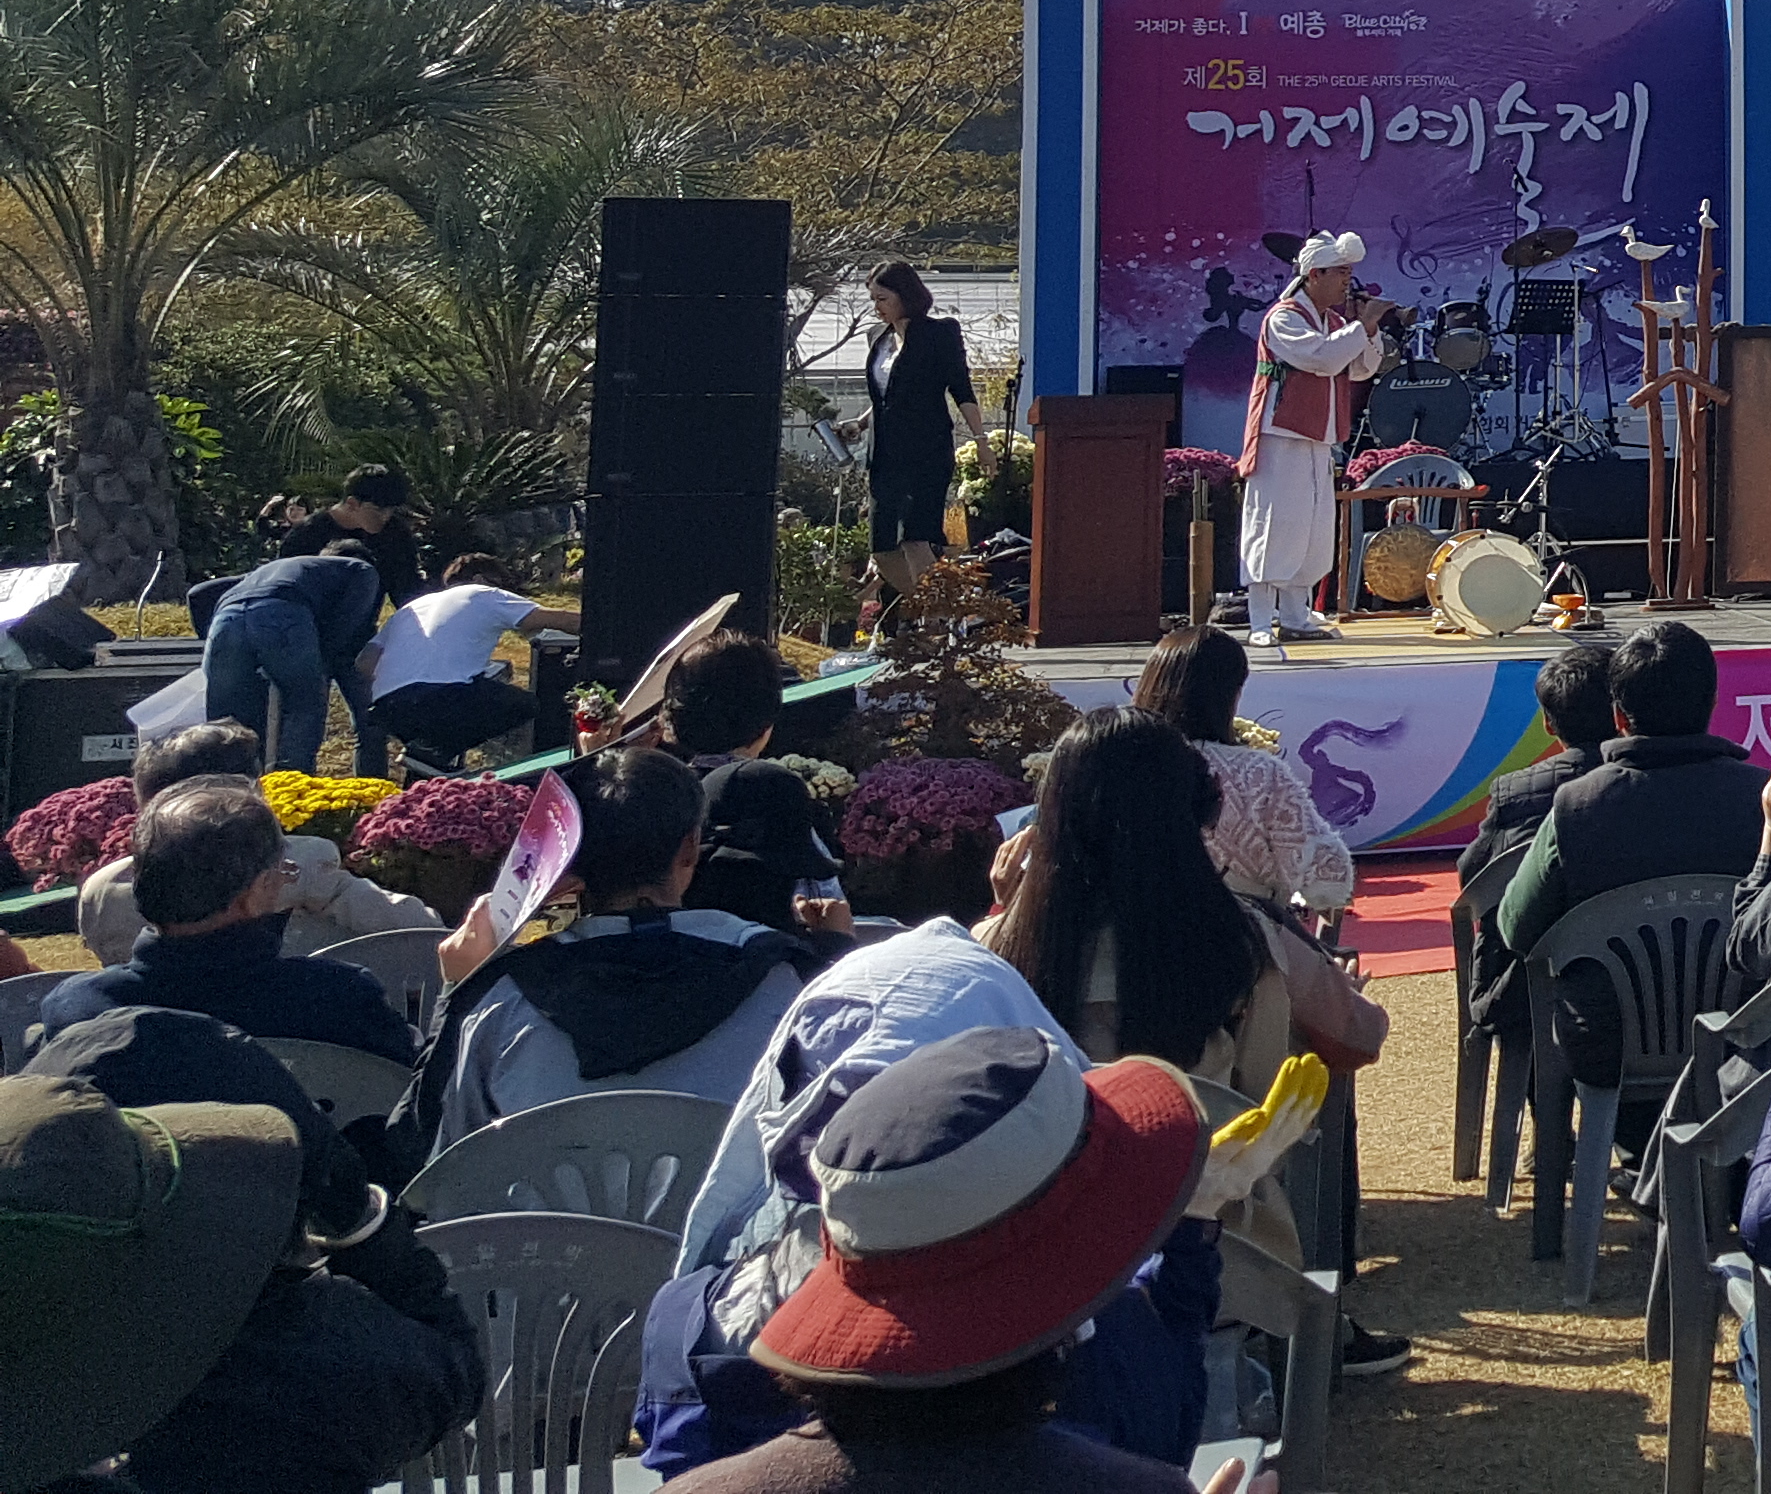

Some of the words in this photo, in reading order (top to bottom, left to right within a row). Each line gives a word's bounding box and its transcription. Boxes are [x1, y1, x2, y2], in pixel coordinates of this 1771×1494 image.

[1135, 18, 1186, 35] 거제가
[1342, 13, 1378, 27] Blue
[1182, 58, 1267, 91] 제25회
[1277, 75, 1301, 88] THE
[1304, 74, 1329, 88] 25th
[1371, 75, 1402, 88] ARTS
[1404, 74, 1459, 88] FESTIVAL
[1186, 81, 1649, 236] 거제예술제
